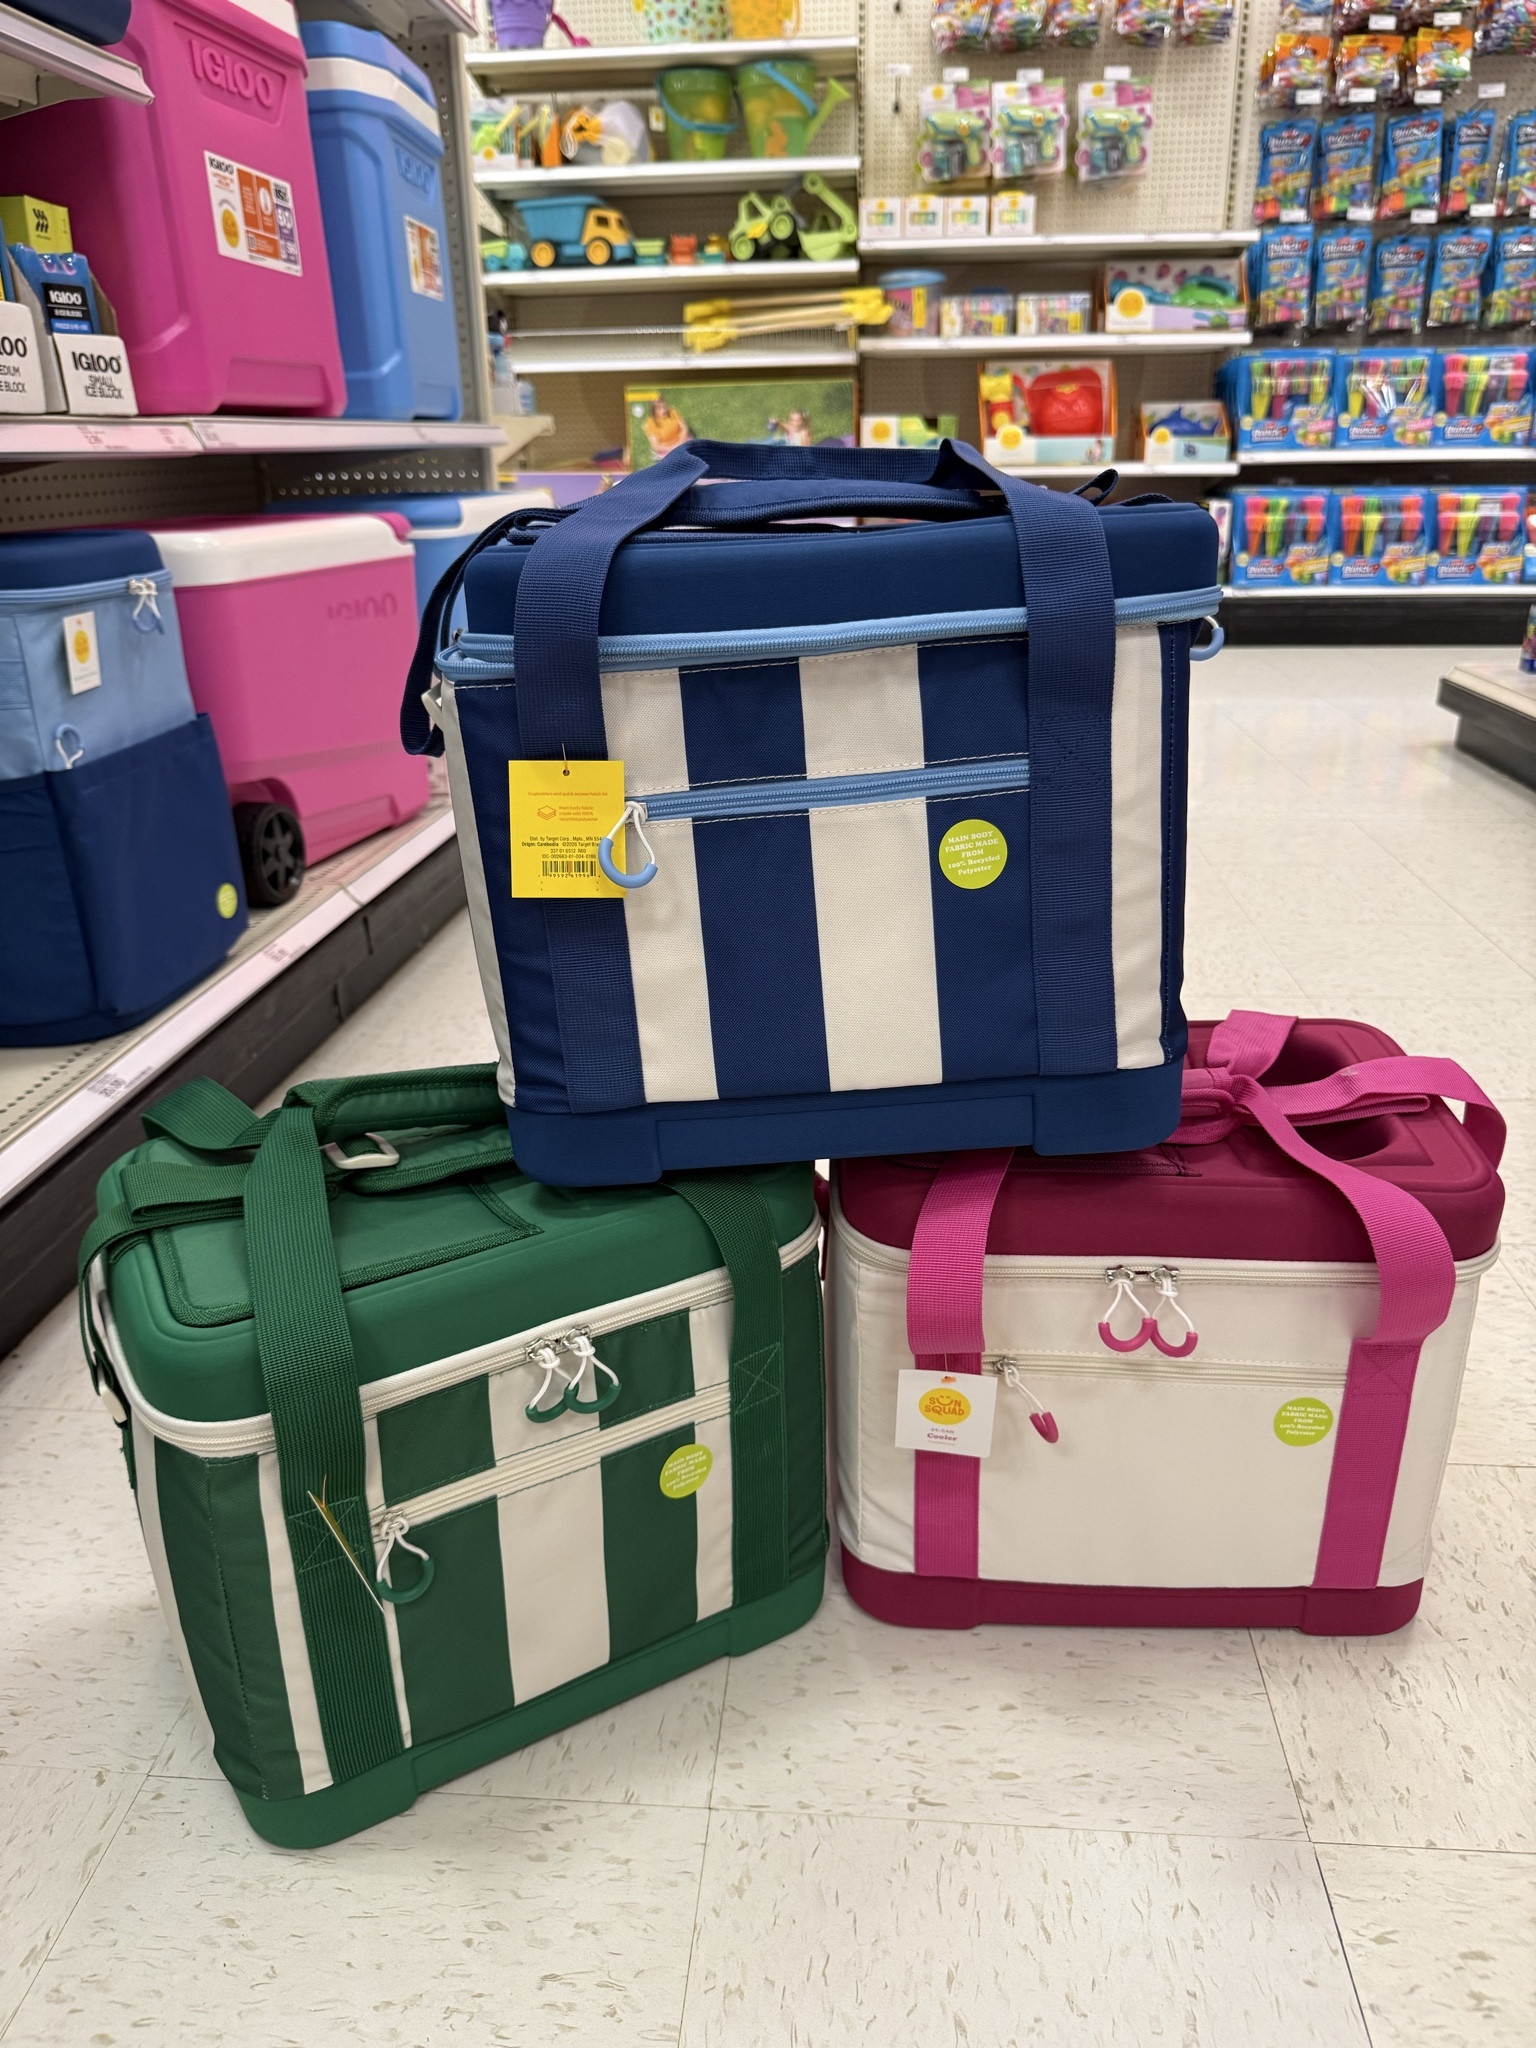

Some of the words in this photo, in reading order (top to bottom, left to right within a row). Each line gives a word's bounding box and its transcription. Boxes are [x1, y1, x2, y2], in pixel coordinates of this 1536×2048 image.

[189, 39, 273, 109] IGLOO
[48, 289, 83, 305] IGLOO
[72, 351, 121, 374] IGLOO
[0, 364, 21, 377] EDIUM
[88, 374, 116, 388] SMALL
[98, 387, 124, 400] BLOCK
[947, 834, 969, 844] MAIN
[970, 830, 993, 840] BODY
[944, 842, 974, 853] FABRIC
[975, 838, 999, 848] MADE
[961, 849, 984, 858] FROM
[947, 861, 967, 869] 100%
[967, 854, 1001, 866] Recycled
[957, 865, 992, 876] Polyester
[929, 1395, 962, 1408] SUN
[924, 1404, 965, 1416] SQUAD
[926, 1432, 958, 1441] Cooler
